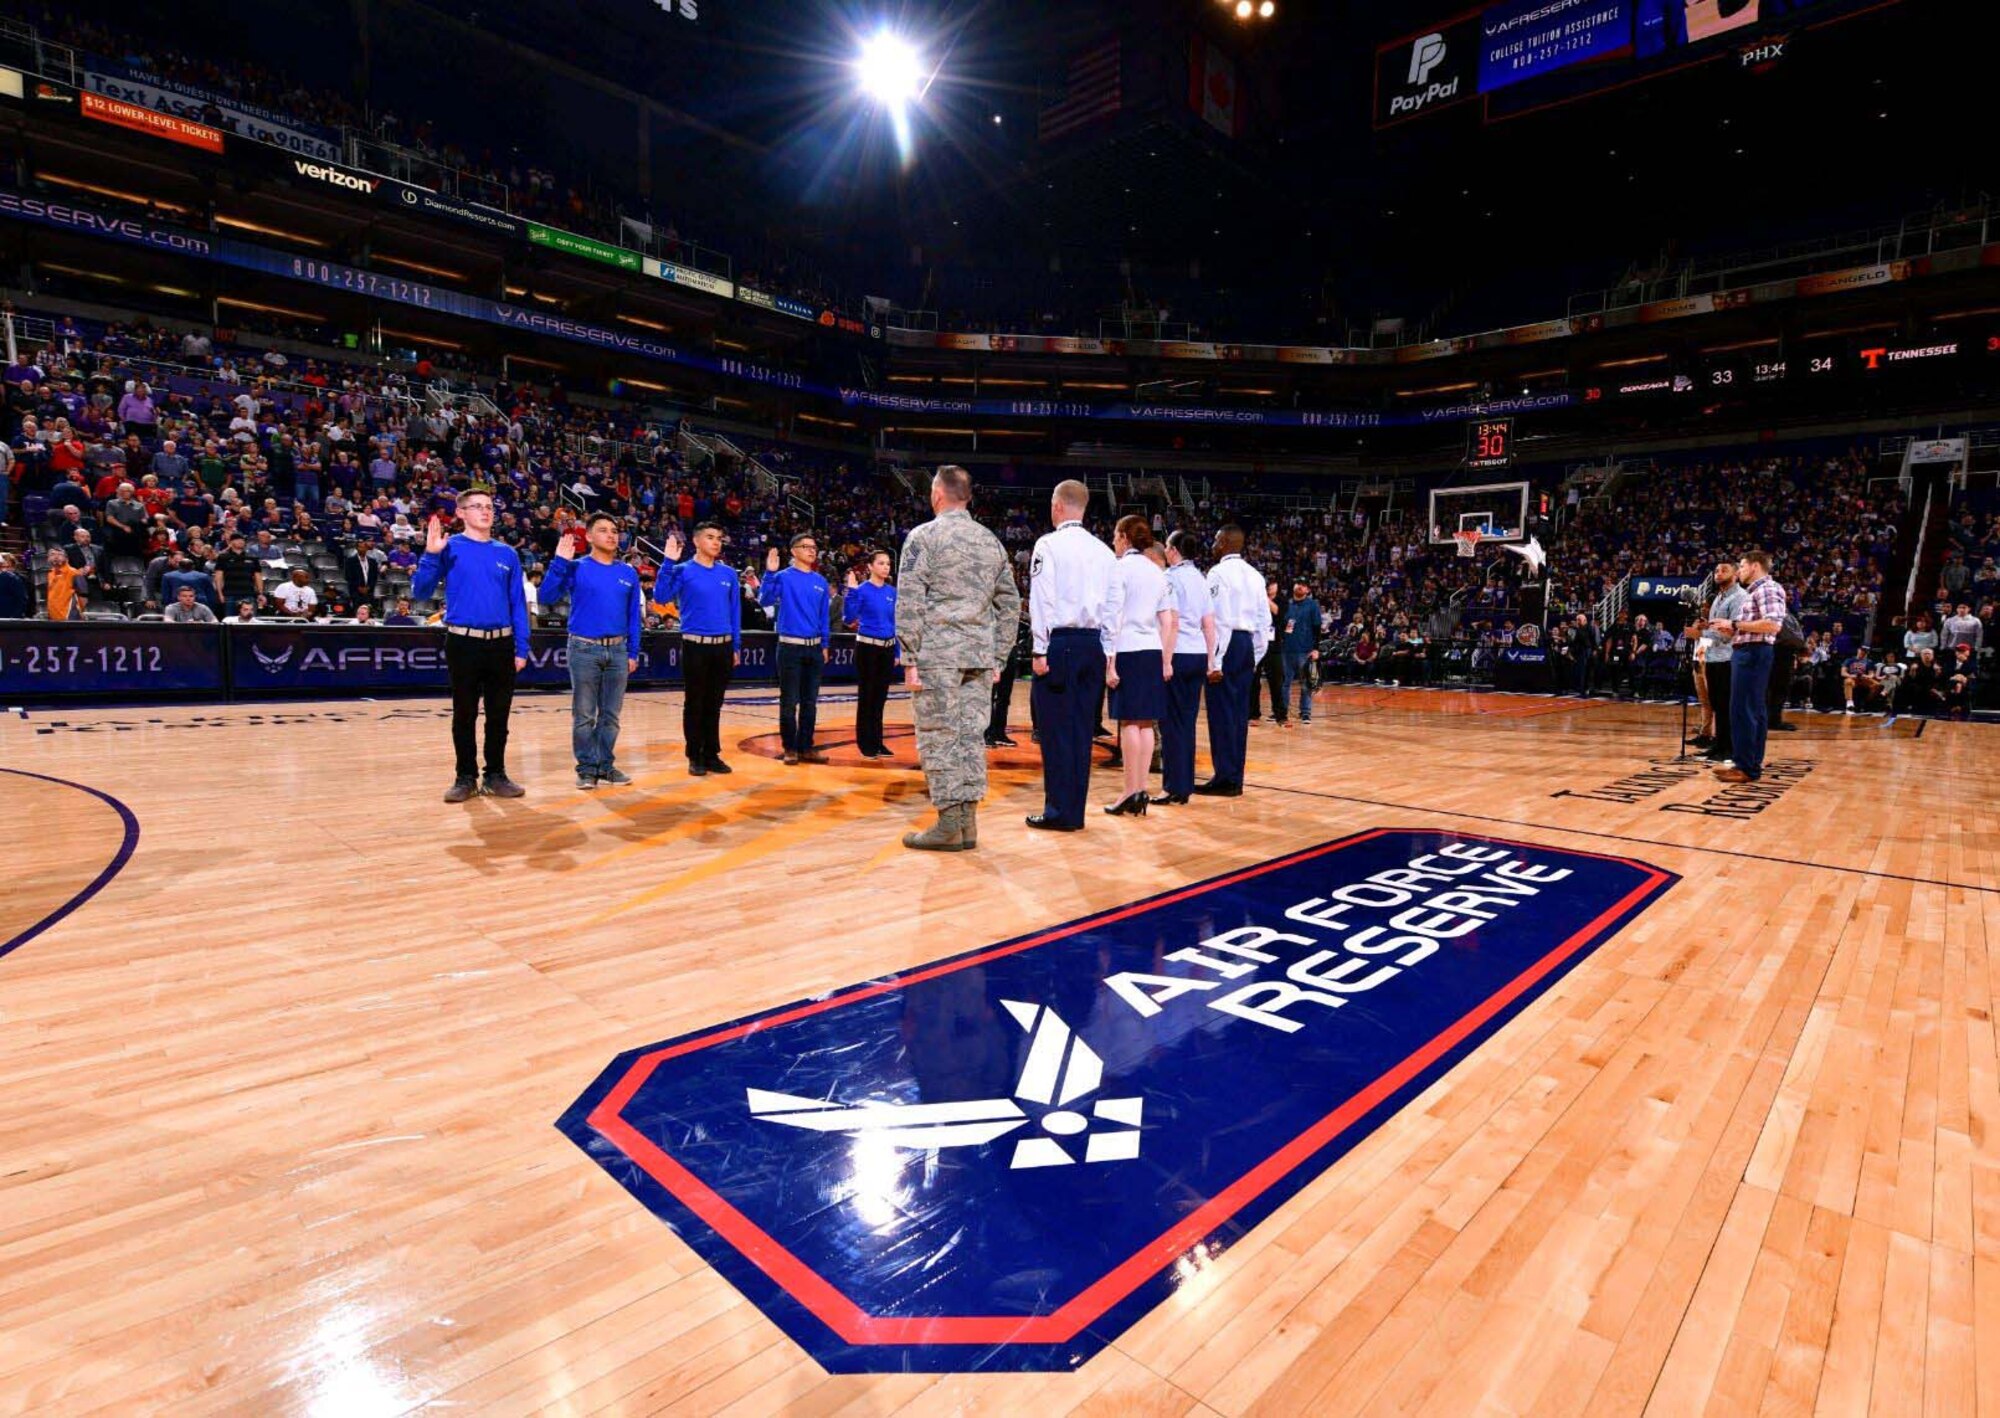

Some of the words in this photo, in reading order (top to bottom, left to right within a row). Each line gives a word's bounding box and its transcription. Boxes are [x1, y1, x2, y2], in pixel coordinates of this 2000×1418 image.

[1490, 40, 1523, 62] COLLEGE
[1528, 27, 1561, 49] TUITION
[1564, 6, 1619, 36] ASSISTANCE
[1742, 44, 1784, 66] PHX
[129, 68, 160, 84] HAVE
[1390, 76, 1458, 115] PayPal
[85, 97, 106, 110] $12
[109, 103, 177, 130] LOWER-LEVEL
[180, 123, 220, 142] TICKETS
[90, 74, 147, 106] Text
[276, 131, 337, 160] 90561
[294, 160, 372, 193] verizon
[424, 198, 516, 231] DiamondResorts.com
[293, 258, 431, 305] 800-257-1212
[514, 311, 677, 359] AFRESERVE.com
[1810, 357, 1832, 373] 34
[1887, 344, 1958, 361] TENNESSEE
[1711, 370, 1733, 385] 33
[1755, 361, 1786, 375] 13:44
[1619, 380, 1670, 394] GONZAGA
[848, 389, 971, 413] AFRESERVE.com
[1144, 407, 1264, 423] AFRESERVE.com
[1478, 423, 1507, 436] 13:44
[1477, 435, 1503, 457] 30
[0, 646, 163, 673] -257-1212
[1104, 925, 1318, 1019] AIR
[1285, 843, 1511, 931] FORCE
[1206, 860, 1574, 1034] RESERVE
